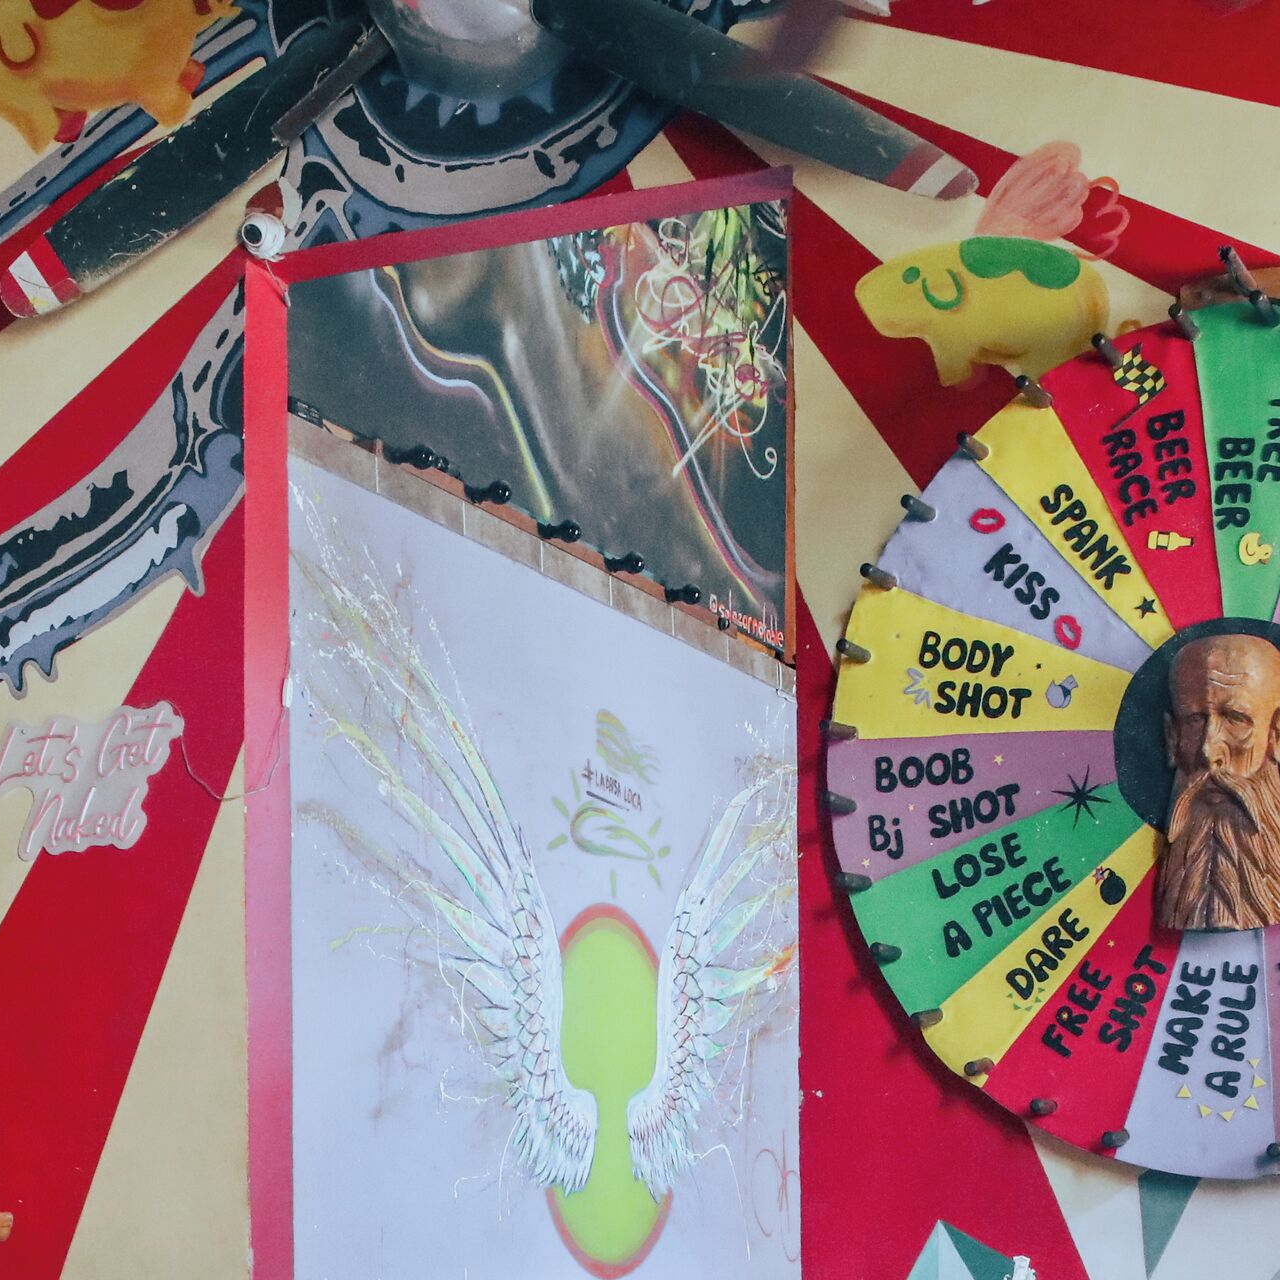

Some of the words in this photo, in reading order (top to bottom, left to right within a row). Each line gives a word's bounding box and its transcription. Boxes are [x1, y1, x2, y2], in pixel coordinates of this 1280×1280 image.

[1103, 428, 1158, 527] RACE
[1147, 410, 1196, 504] BEER
[1214, 437, 1256, 531] BEER
[983, 543, 1060, 620] KISS
[1040, 484, 1132, 590] SPANK
[919, 632, 1014, 677] BODY
[935, 681, 1032, 719] SHOT
[97, 710, 174, 778] Get
[875, 748, 974, 793] BOOB
[26, 786, 139, 853] Naked
[868, 814, 904, 859] Bj
[929, 784, 1020, 838] SHOT
[932, 832, 1027, 898] LOSE
[943, 920, 973, 957] A
[972, 856, 1071, 937] PIECE
[1006, 908, 1090, 1000] DARE
[1099, 945, 1167, 1053] SHOT
[1041, 960, 1113, 1059] FREE
[1158, 961, 1216, 1075] MAKE
[1211, 961, 1259, 1063] RULE
[1205, 1071, 1241, 1098] A
